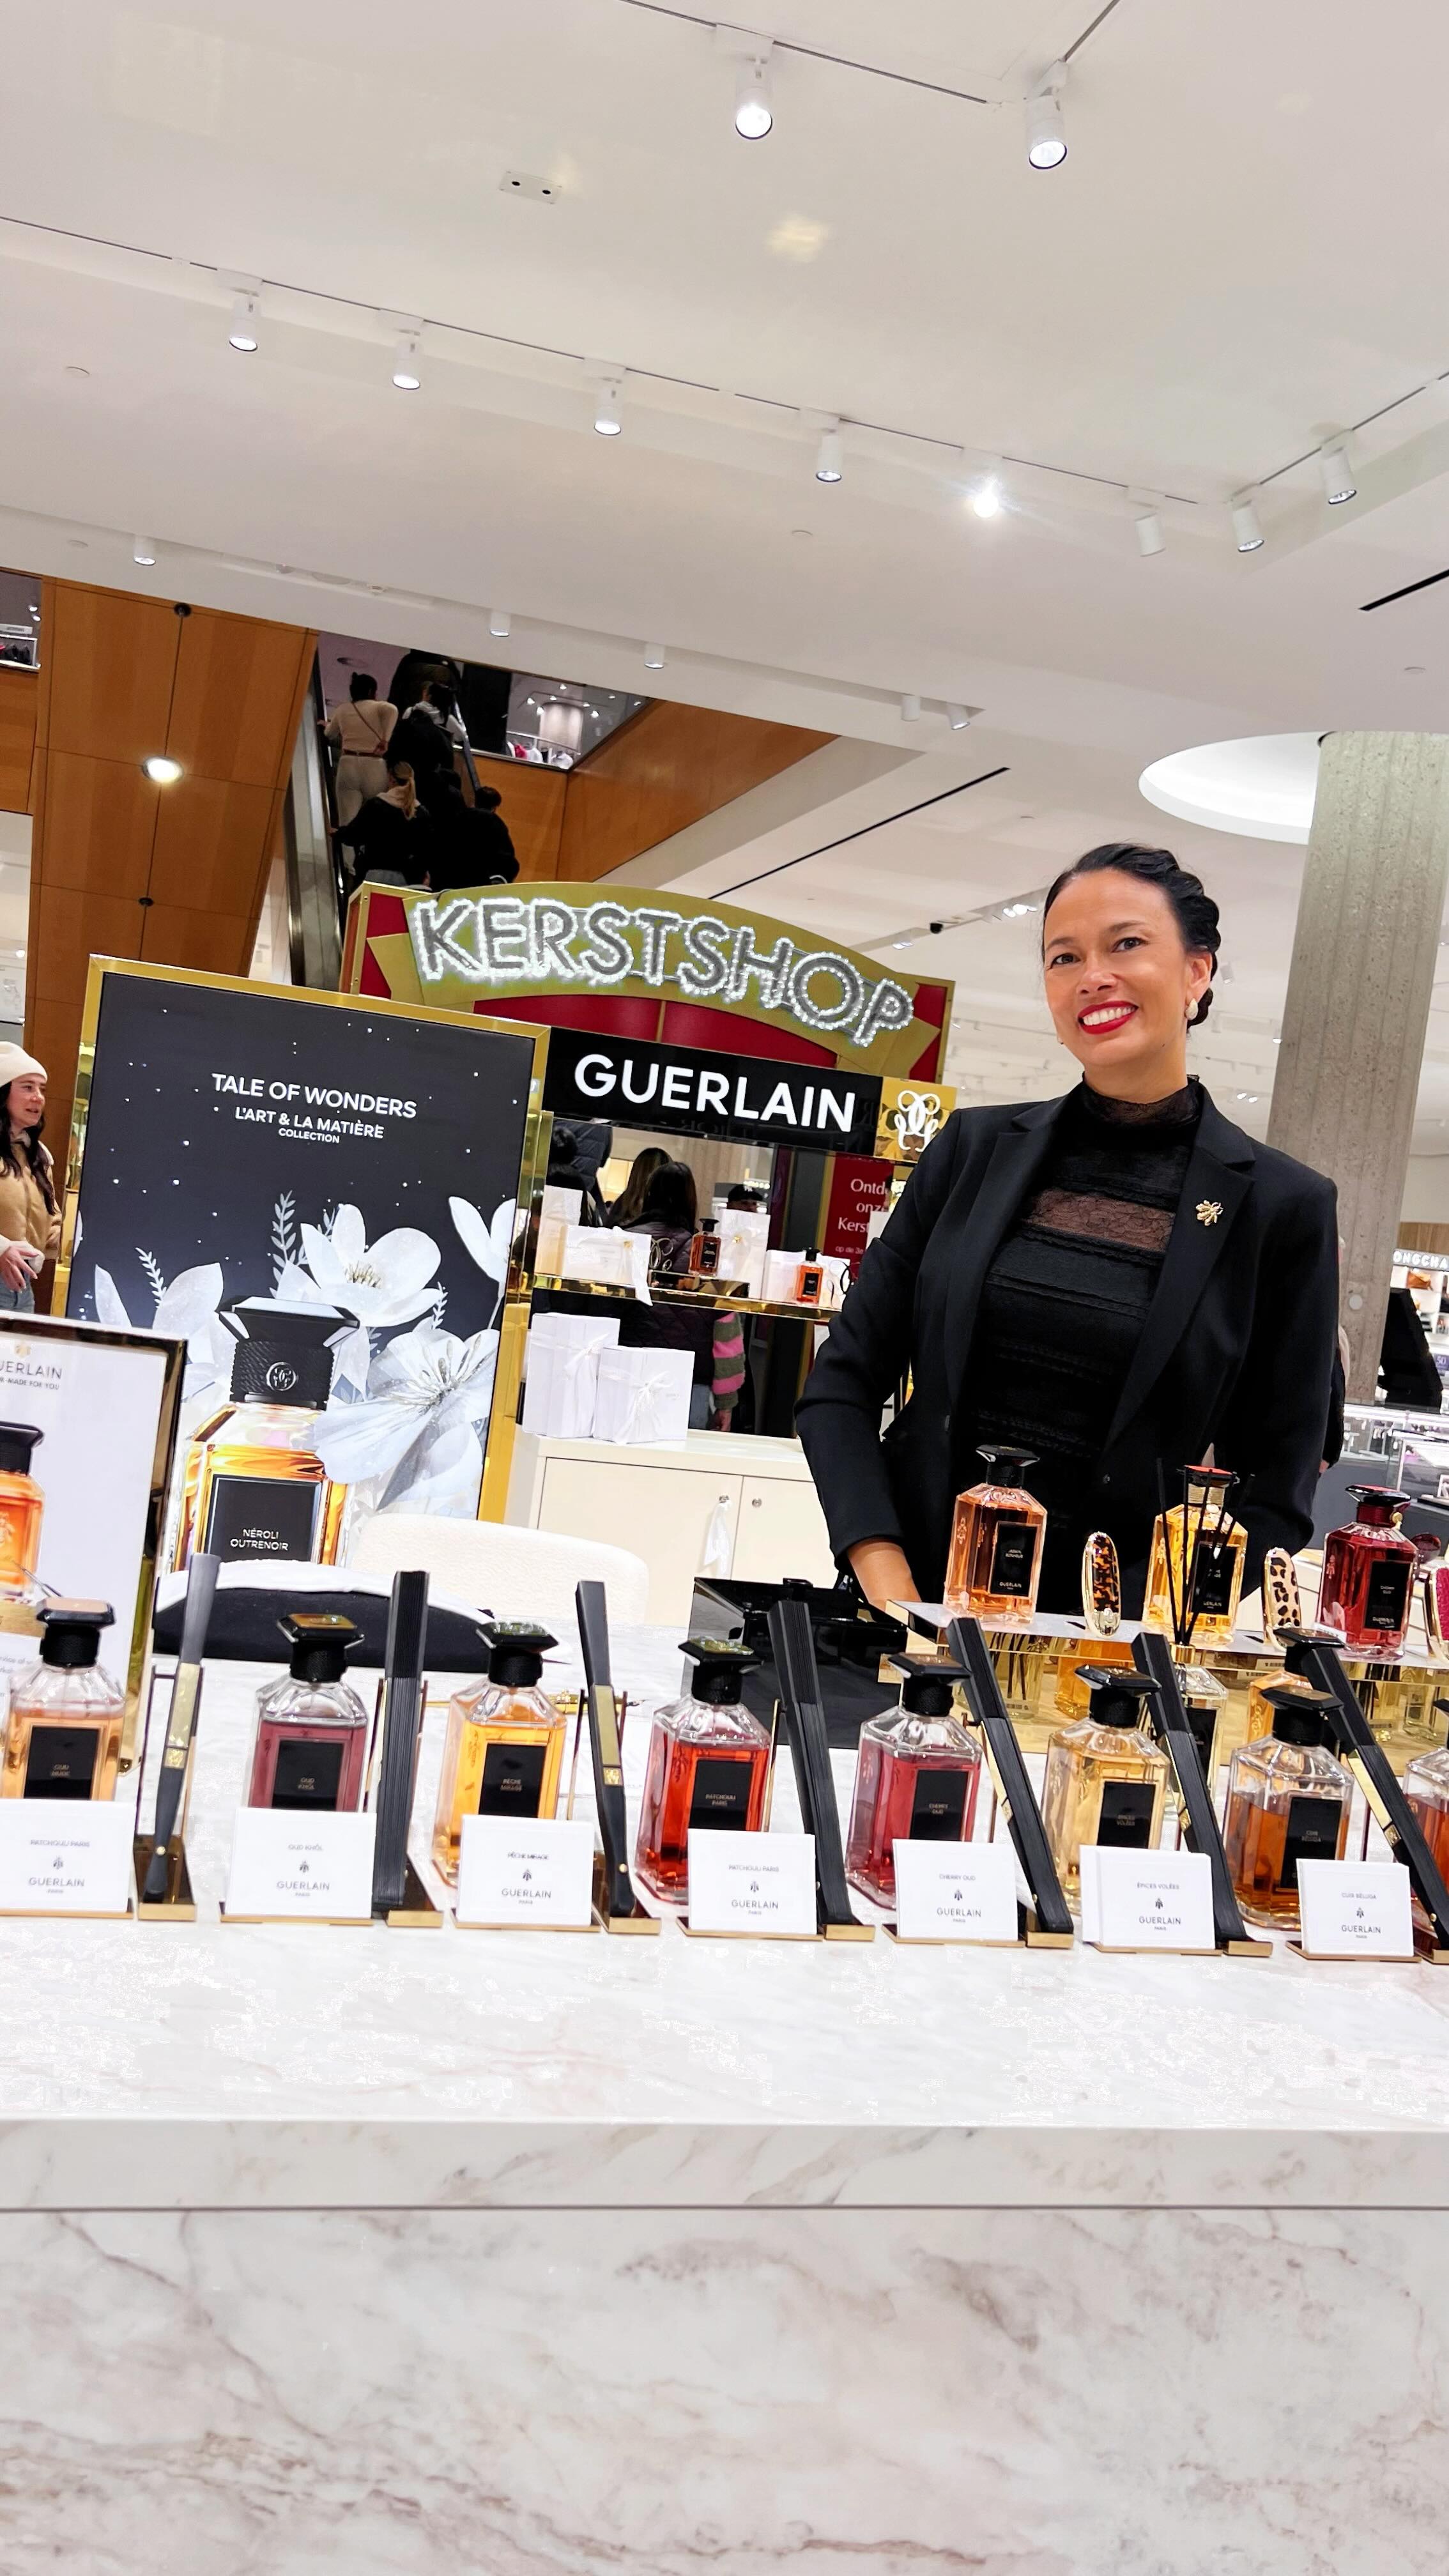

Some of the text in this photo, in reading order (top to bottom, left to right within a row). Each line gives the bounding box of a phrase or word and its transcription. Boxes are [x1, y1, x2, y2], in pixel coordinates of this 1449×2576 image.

[410, 898, 916, 1047] KERSTSHOP
[211, 1073, 417, 1119] TALE OF WONDERS
[574, 1053, 856, 1133] GUERLAIN
[235, 1107, 385, 1139] L'ART & LA MATIÈRE
[278, 1127, 341, 1144] COLLECTION
[835, 1245, 845, 1254] op
[243, 1527, 279, 1539] NÉROLI
[230, 1538, 289, 1551] OUTRENOIR
[29, 1876, 86, 1887] GUERLAIN
[276, 1880, 330, 1891] GUERLAIN
[501, 1887, 552, 1898] GUERLAIN
[731, 1899, 779, 1909] GUERLAIN
[936, 1906, 982, 1917] GUERLAIN
[1138, 1915, 1181, 1925] GUERLAIN
[1341, 1924, 1381, 1934] GUERLAIN
